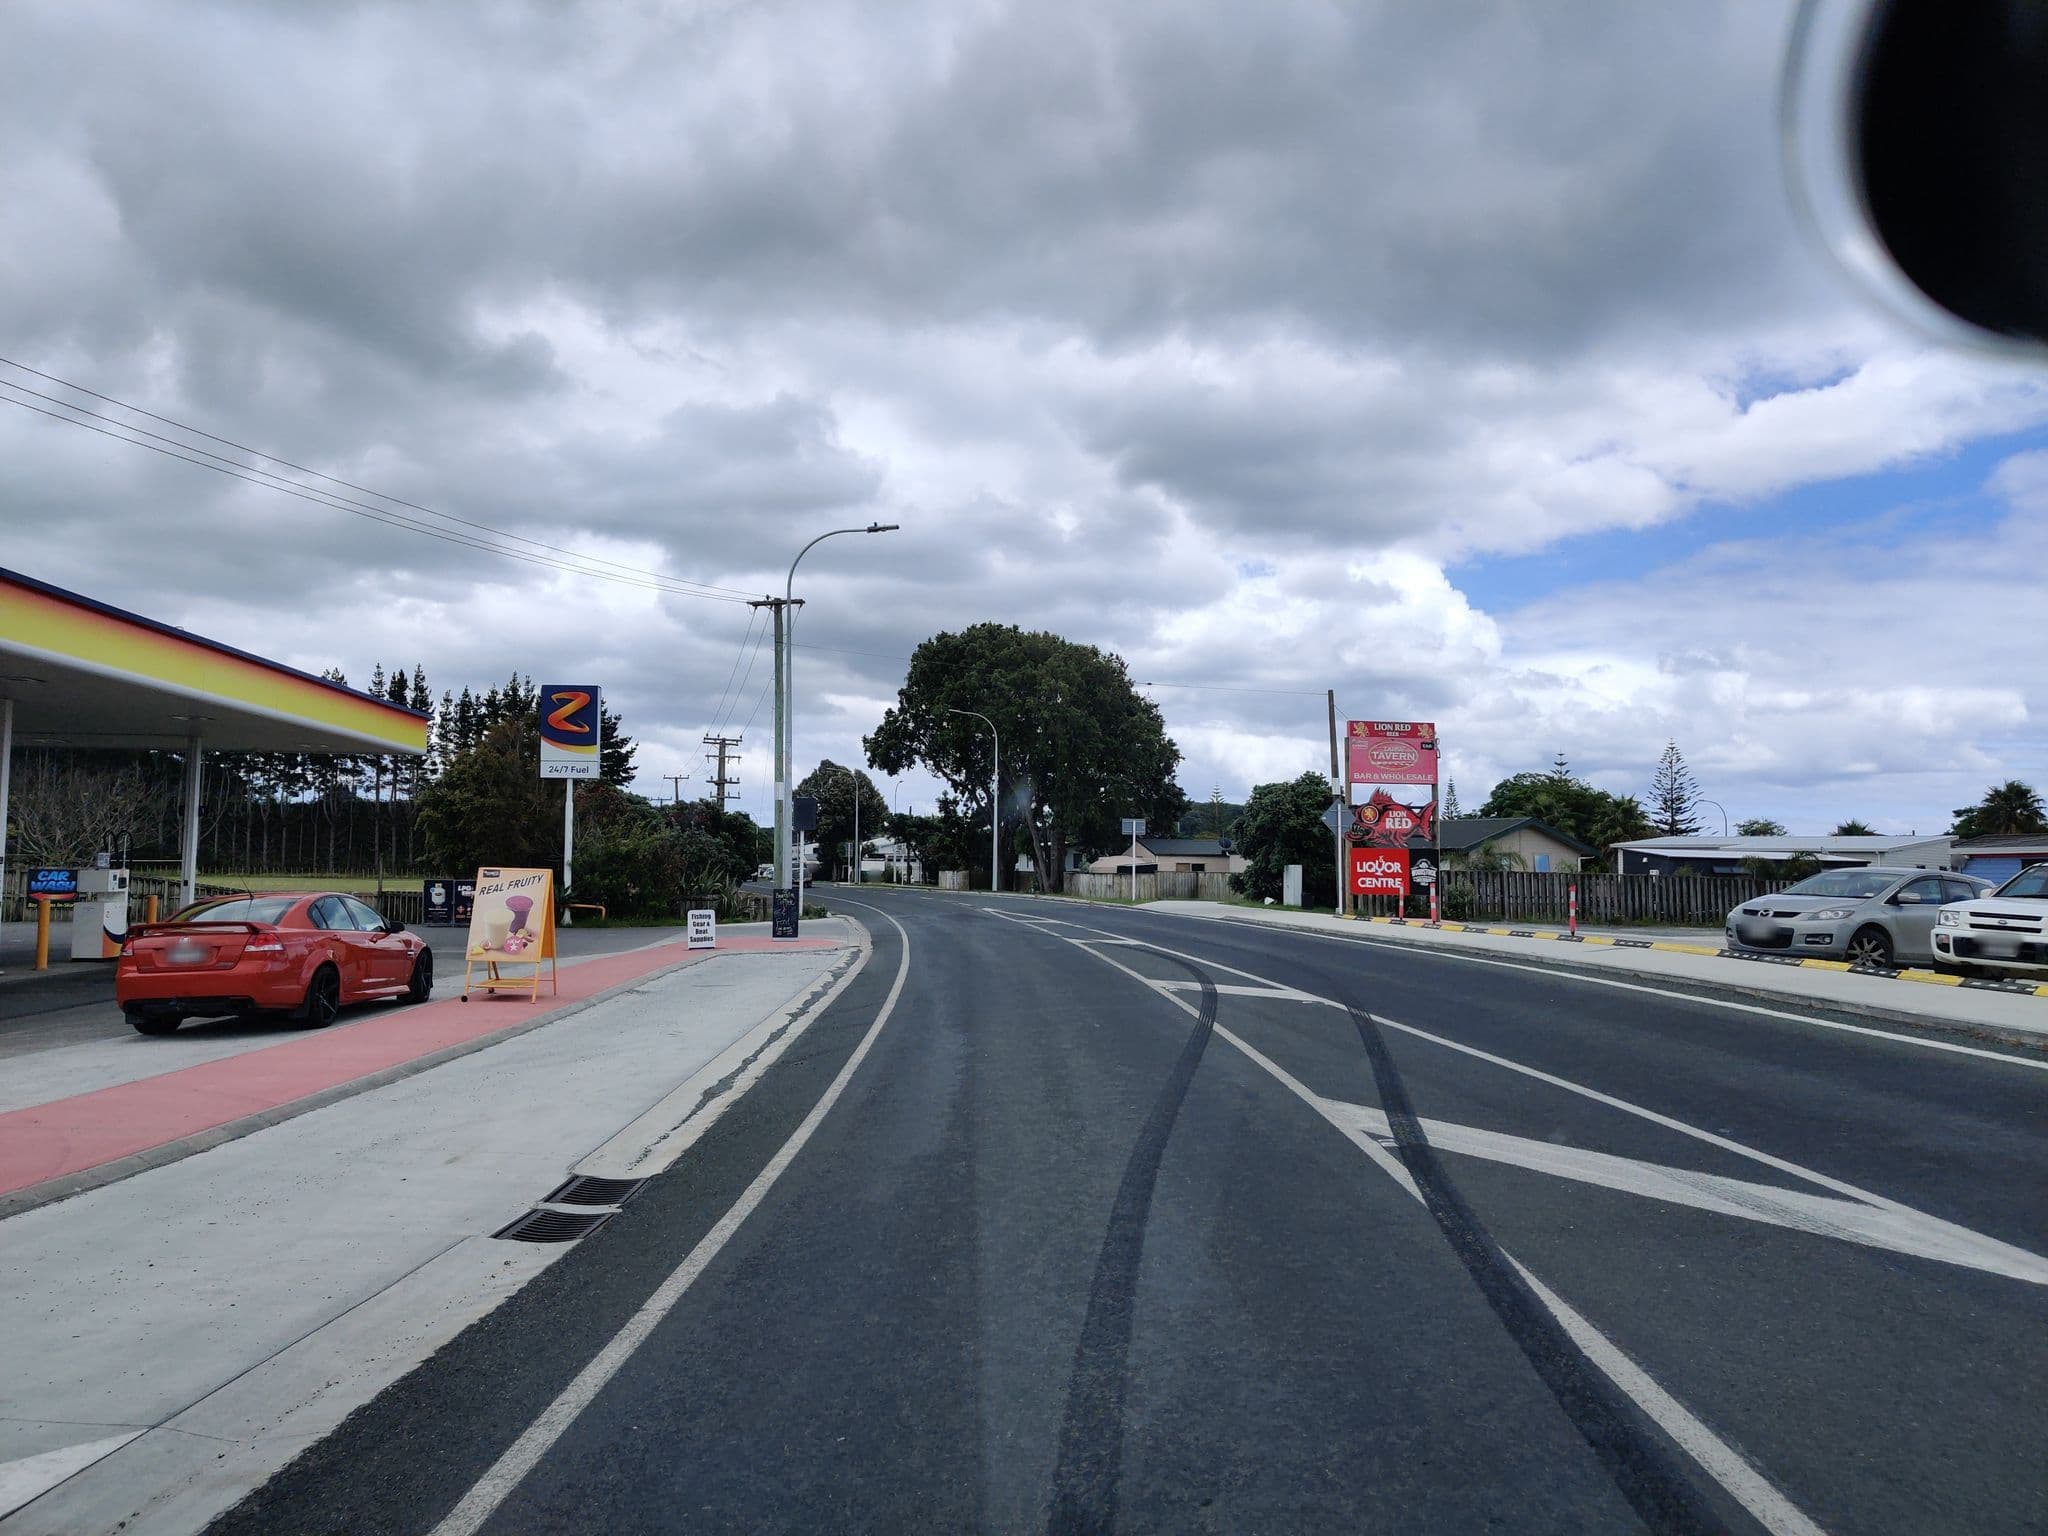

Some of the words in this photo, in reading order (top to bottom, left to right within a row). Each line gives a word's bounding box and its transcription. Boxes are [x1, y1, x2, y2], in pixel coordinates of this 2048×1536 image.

[1374, 723, 1393, 731] LION
[1395, 723, 1411, 732] RED
[1371, 751, 1415, 761] TAVERN
[548, 765, 568, 774] 24/7
[570, 765, 589, 774] Fuel
[1353, 772, 1372, 780] BAR
[1381, 773, 1433, 781] WHOLESALE
[1385, 817, 1412, 829] RED
[1356, 858, 1402, 875] LIQUOR
[37, 870, 70, 880] CAR
[31, 881, 76, 891] WASH
[479, 883, 504, 896] REAL
[507, 874, 544, 890] FRUITY
[1357, 877, 1402, 888] CENTRE
